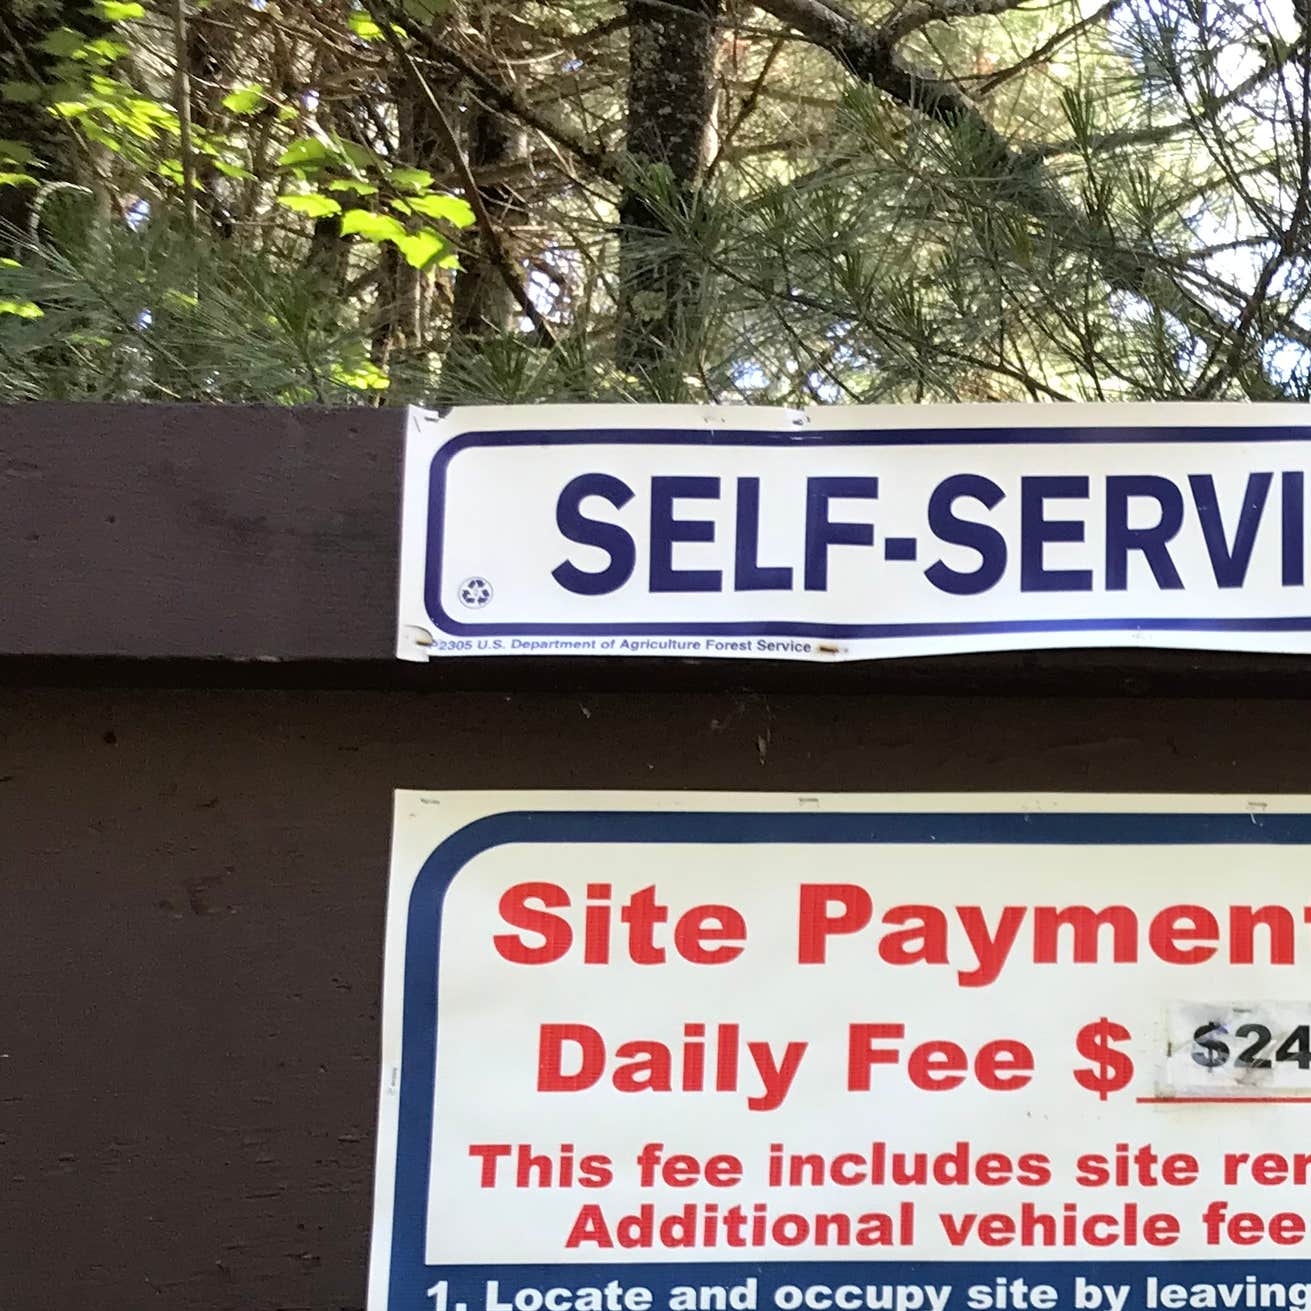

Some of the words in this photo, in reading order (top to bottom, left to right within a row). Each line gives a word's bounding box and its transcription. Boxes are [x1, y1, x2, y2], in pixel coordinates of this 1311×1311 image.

[477, 639, 505, 650] U.S.
[511, 639, 596, 651] Department
[601, 639, 616, 650] of
[620, 639, 700, 652] Agriculture
[705, 639, 752, 651] Forest
[757, 639, 812, 653] Service
[494, 882, 746, 964] Site
[537, 1023, 806, 1111] Daily
[848, 1024, 1033, 1091] Fee
[1074, 1018, 1133, 1101] $
[469, 1144, 612, 1187] This
[637, 1143, 742, 1187] fee
[769, 1142, 1051, 1186] includes
[1077, 1144, 1198, 1187] site
[566, 1202, 913, 1248] Additional
[940, 1203, 1180, 1246] vehicle
[1203, 1201, 1305, 1245] fee
[428, 1281, 466, 1311] 1.
[486, 1281, 652, 1311] Locate
[669, 1278, 757, 1311] and
[968, 1278, 1057, 1309] site
